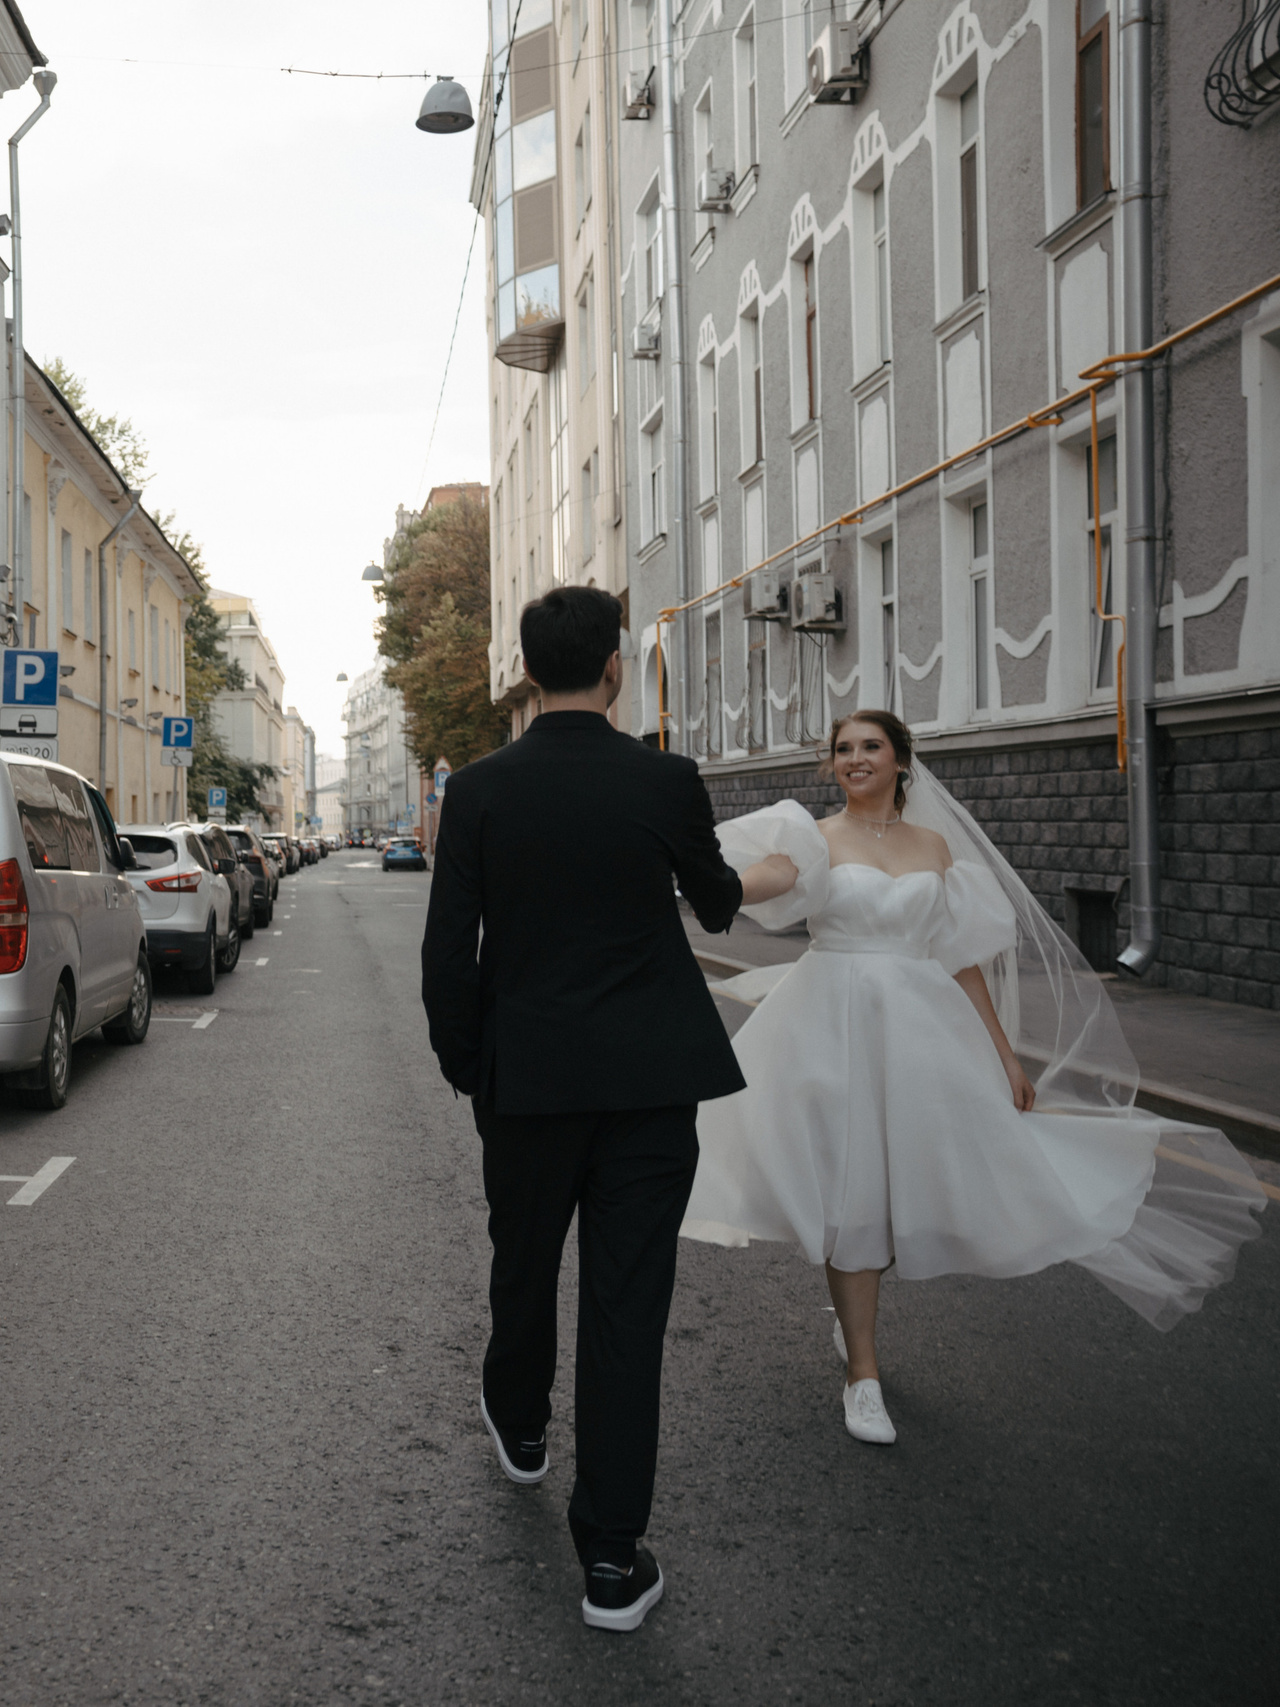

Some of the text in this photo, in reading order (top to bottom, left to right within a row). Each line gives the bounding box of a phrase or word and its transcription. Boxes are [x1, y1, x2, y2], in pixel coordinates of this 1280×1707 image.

[15, 655, 46, 701] P
[170, 720, 189, 745] P
[34, 747, 50, 760] 20
[212, 790, 223, 805] P
